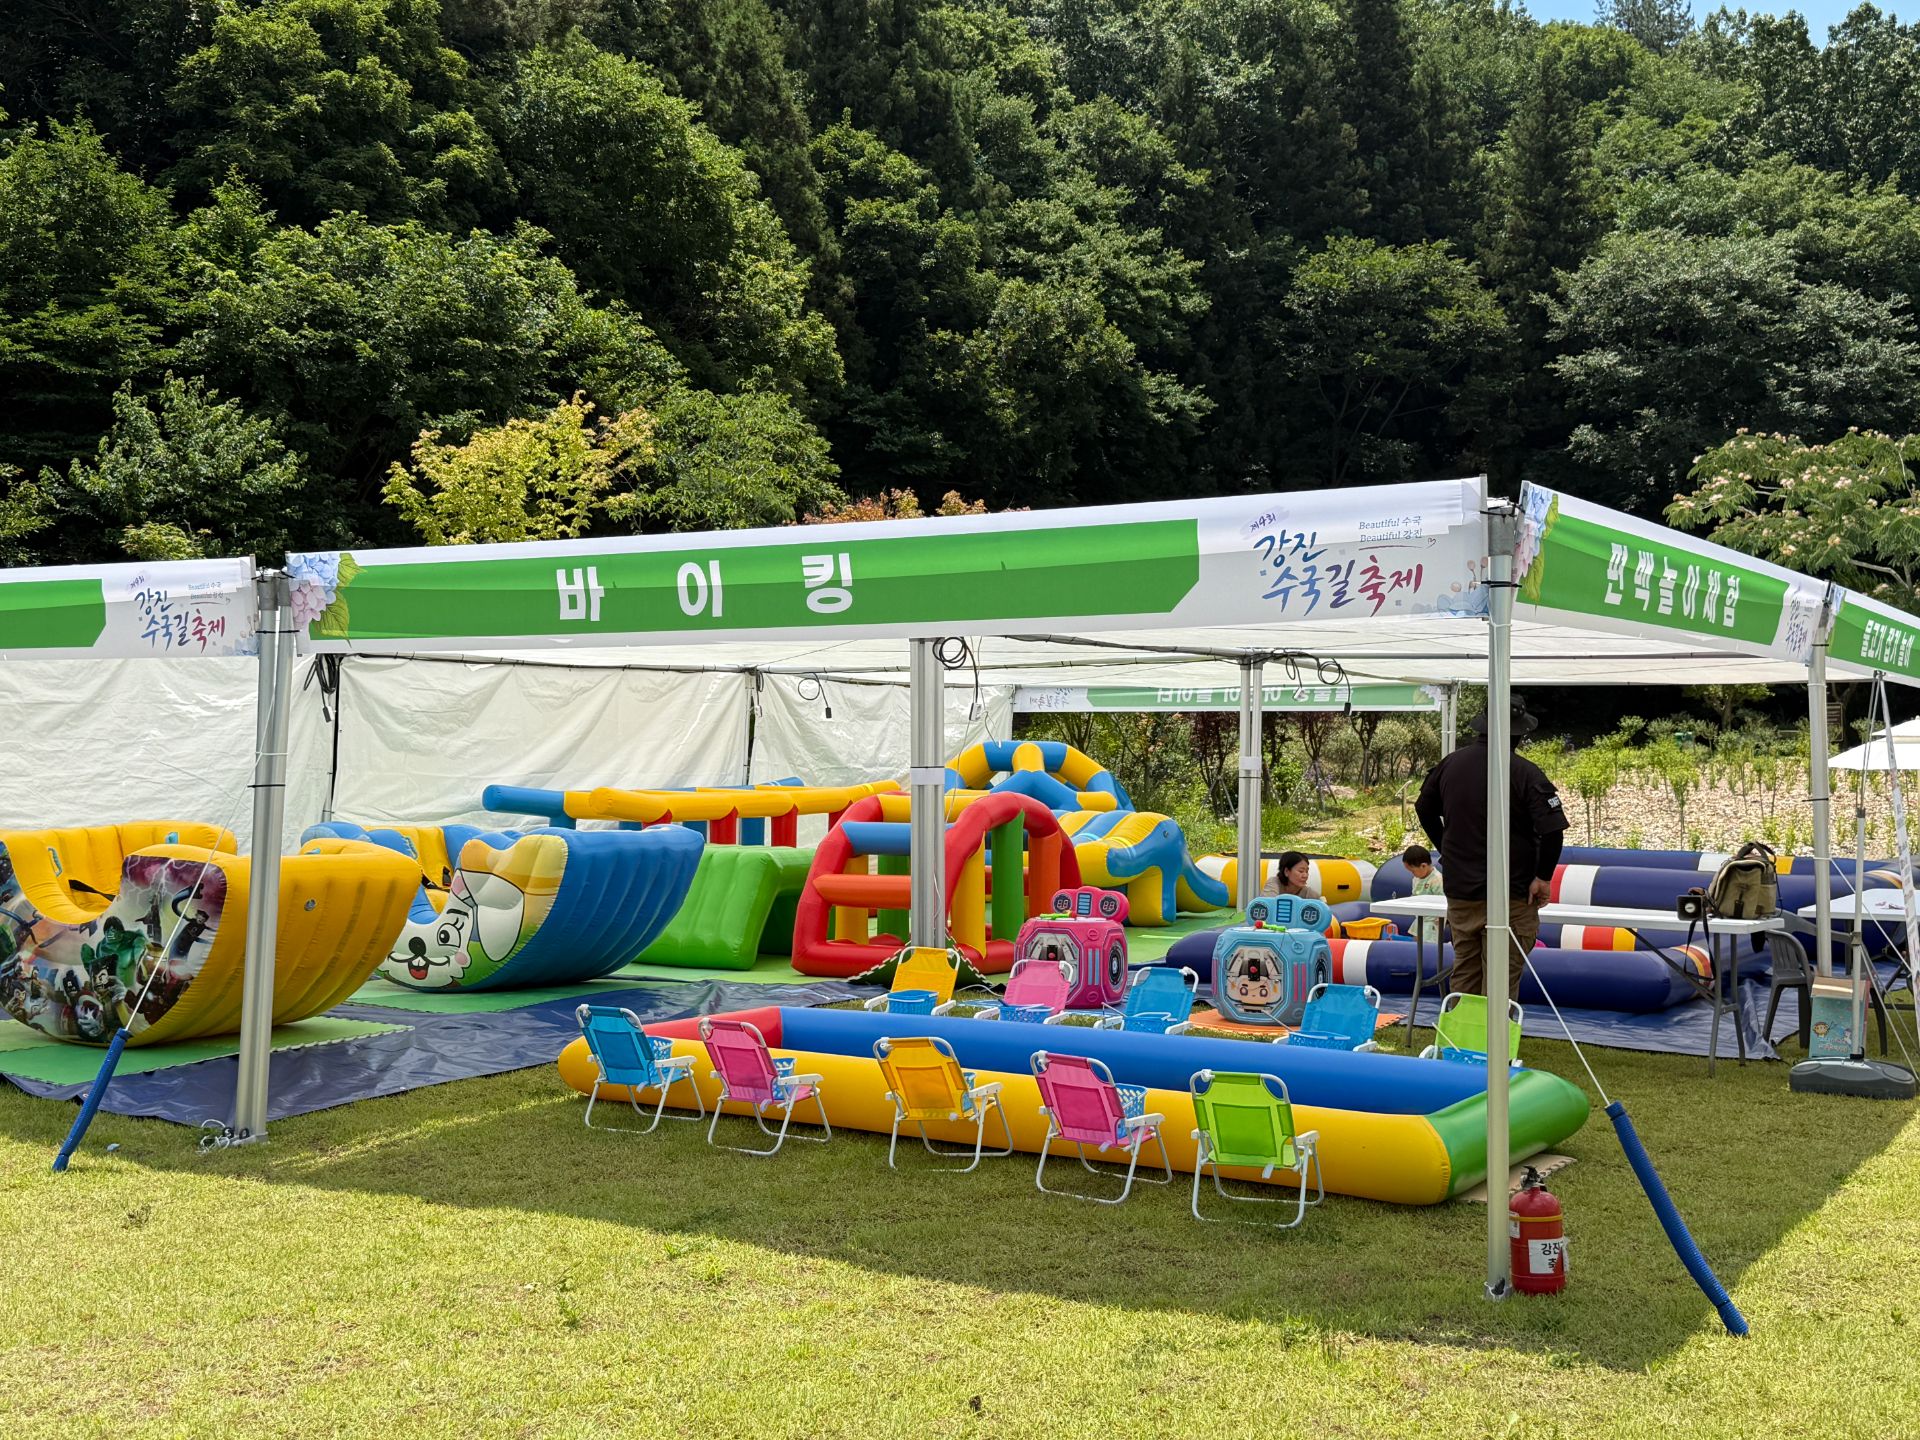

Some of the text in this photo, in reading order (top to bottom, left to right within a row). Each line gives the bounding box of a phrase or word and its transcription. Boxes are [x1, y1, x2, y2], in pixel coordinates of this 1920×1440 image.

[1359, 515, 1422, 530] Beautiful 수국
[1360, 528, 1422, 543] Beautiful 강진
[1253, 529, 1328, 568] 강진
[134, 588, 174, 615] 강진
[1541, 1241, 1563, 1256] 강진
